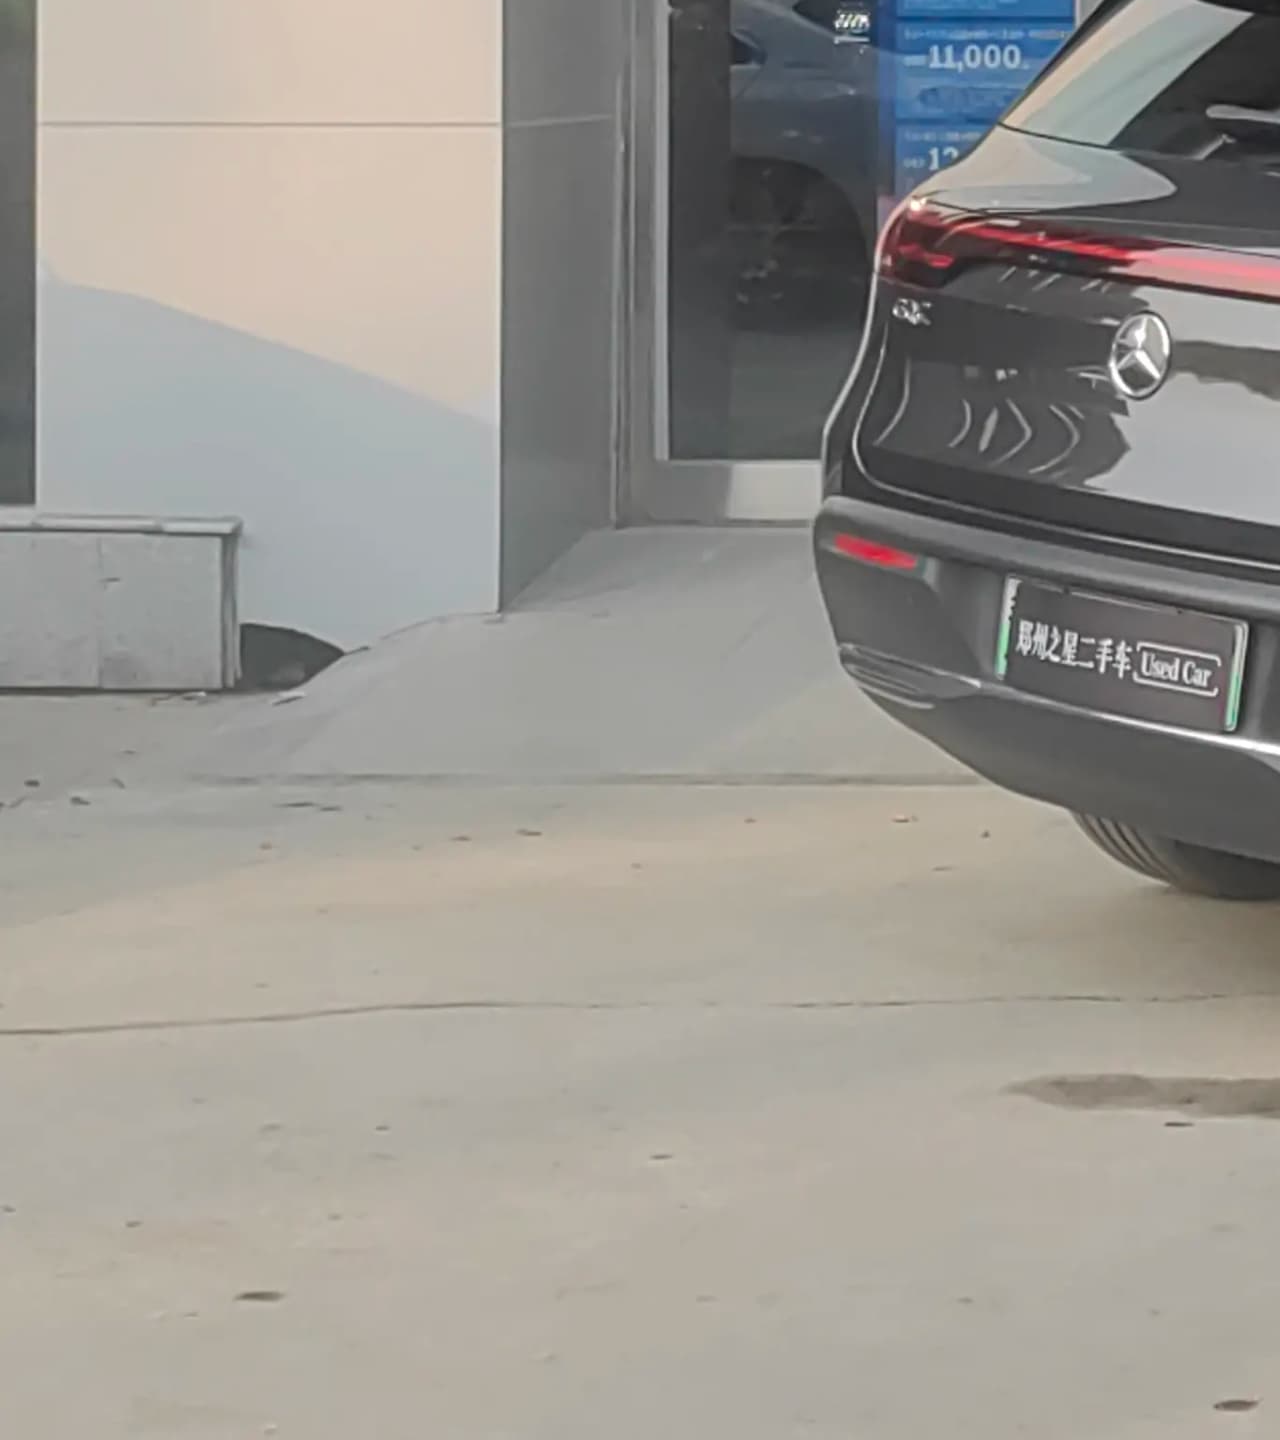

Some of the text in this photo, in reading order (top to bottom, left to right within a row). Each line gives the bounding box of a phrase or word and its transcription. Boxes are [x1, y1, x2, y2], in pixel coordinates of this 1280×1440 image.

[928, 43, 1022, 72] 11,000
[1015, 619, 1133, 680] 郑州之星二手车
[1140, 649, 1213, 689] Used Car
